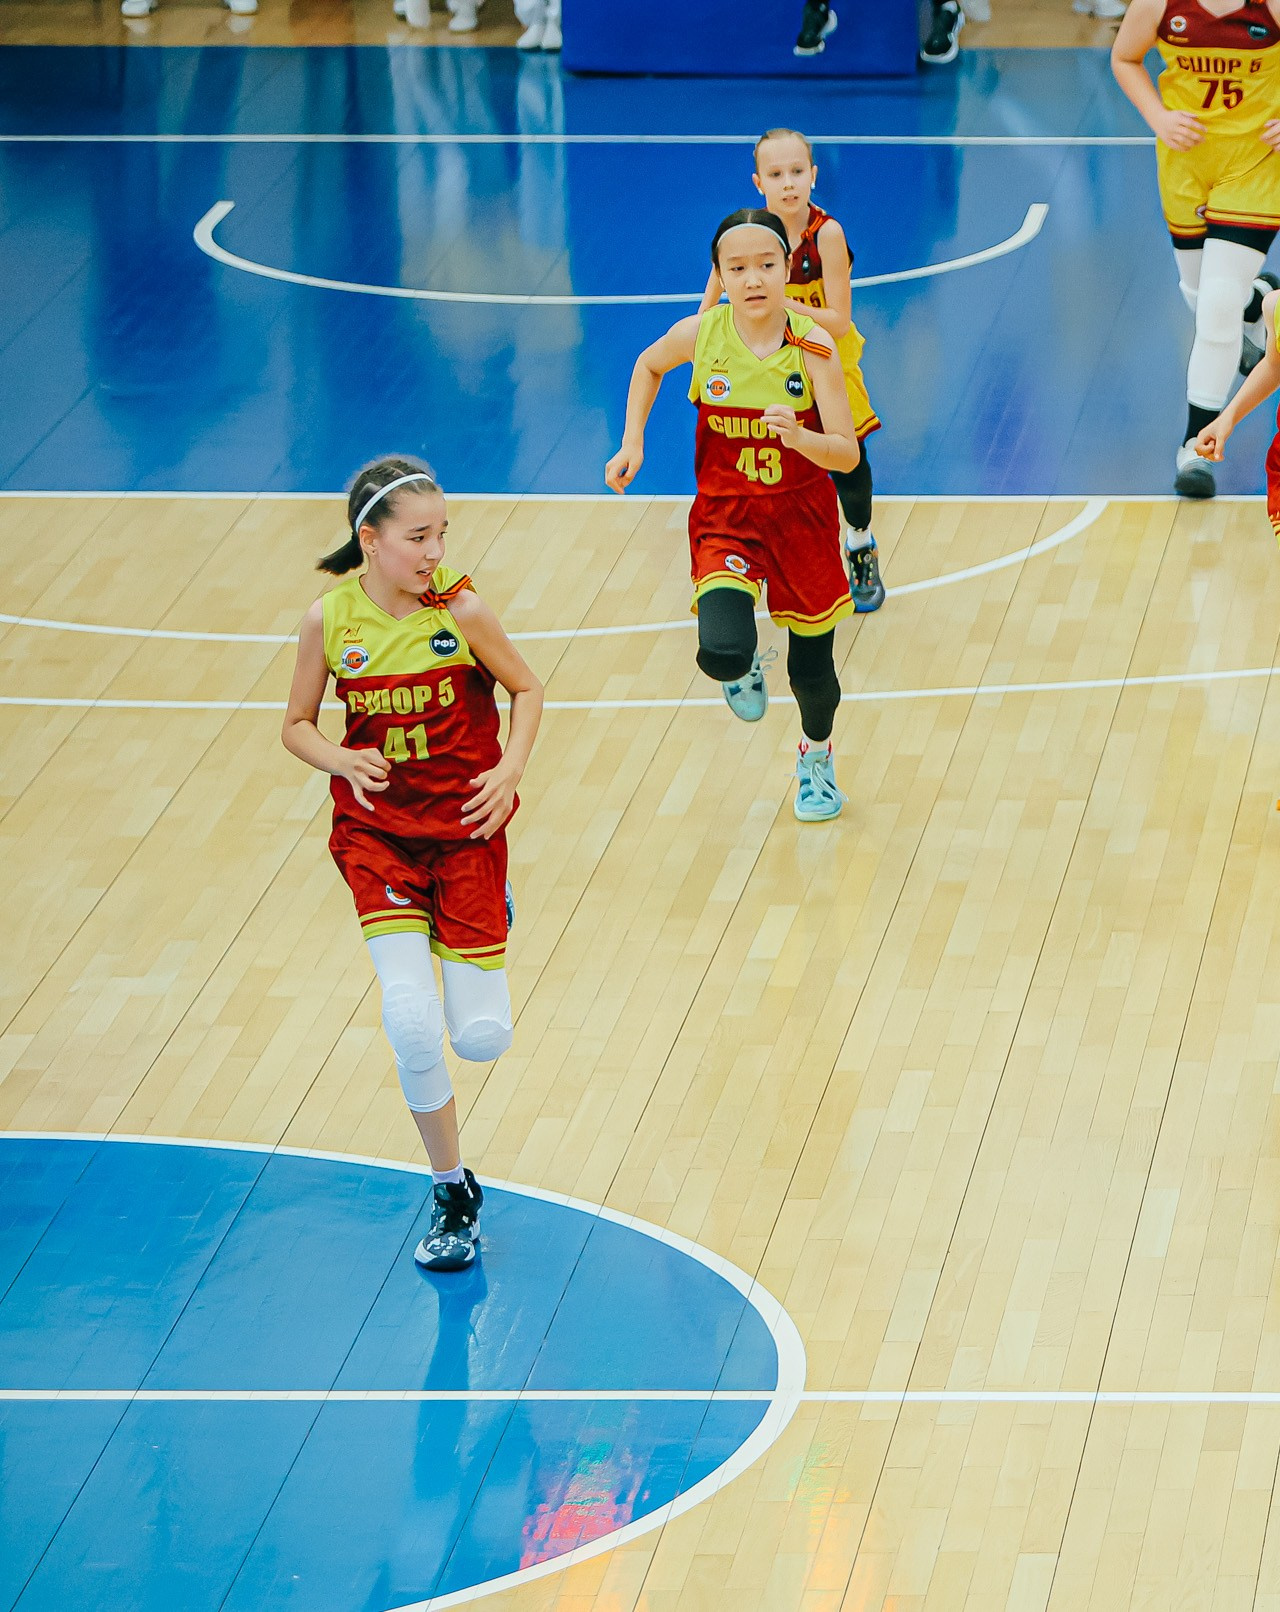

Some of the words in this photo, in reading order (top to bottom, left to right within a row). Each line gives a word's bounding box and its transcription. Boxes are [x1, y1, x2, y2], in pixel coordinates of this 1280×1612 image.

[1176, 54, 1242, 75] СШОР
[1198, 79, 1244, 110] 75
[707, 414, 777, 440] СШО
[735, 446, 784, 486] 43
[433, 638, 456, 648] РФБ
[346, 684, 433, 717] СШОР
[437, 675, 456, 708] 5
[382, 723, 430, 763] 41
